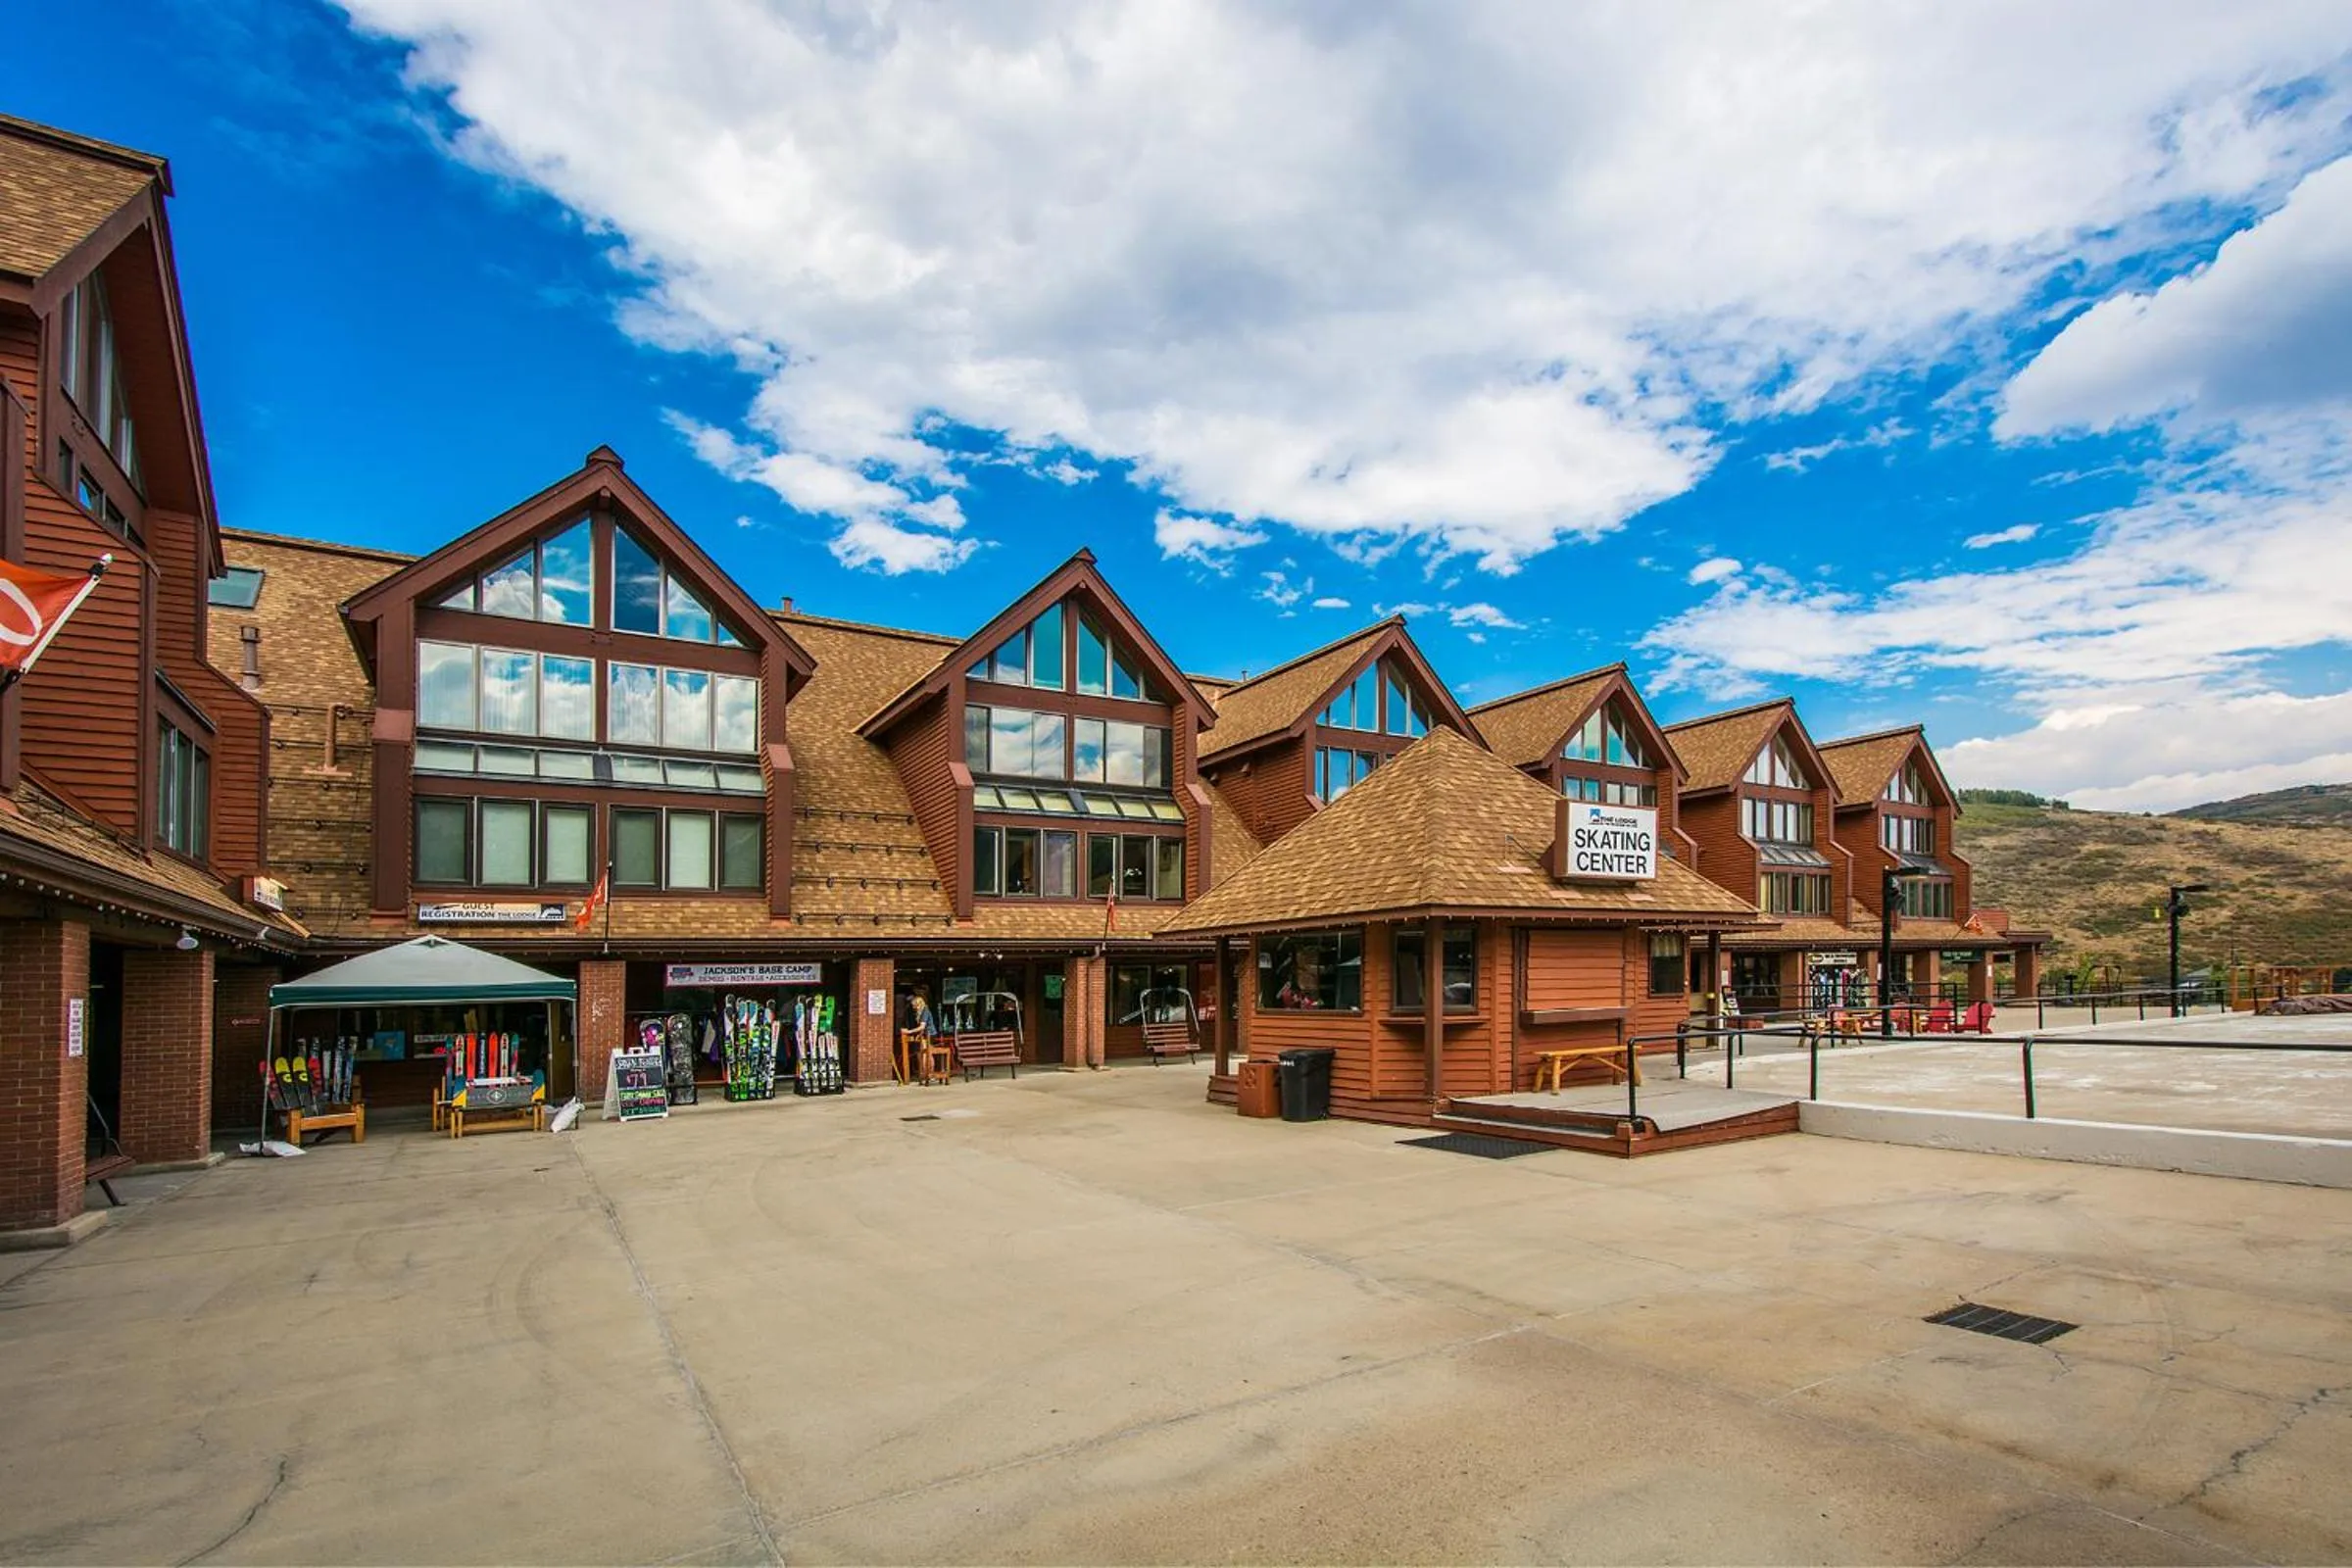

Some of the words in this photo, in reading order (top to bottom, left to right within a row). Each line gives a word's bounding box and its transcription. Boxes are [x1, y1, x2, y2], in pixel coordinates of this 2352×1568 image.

[1574, 828, 1650, 852] SKATING
[1577, 852, 1646, 873] CENTER
[462, 902, 494, 910] GUEST
[704, 966, 755, 975] JACKSON'S
[759, 965, 783, 974] BASE
[785, 964, 812, 973] CAMP
